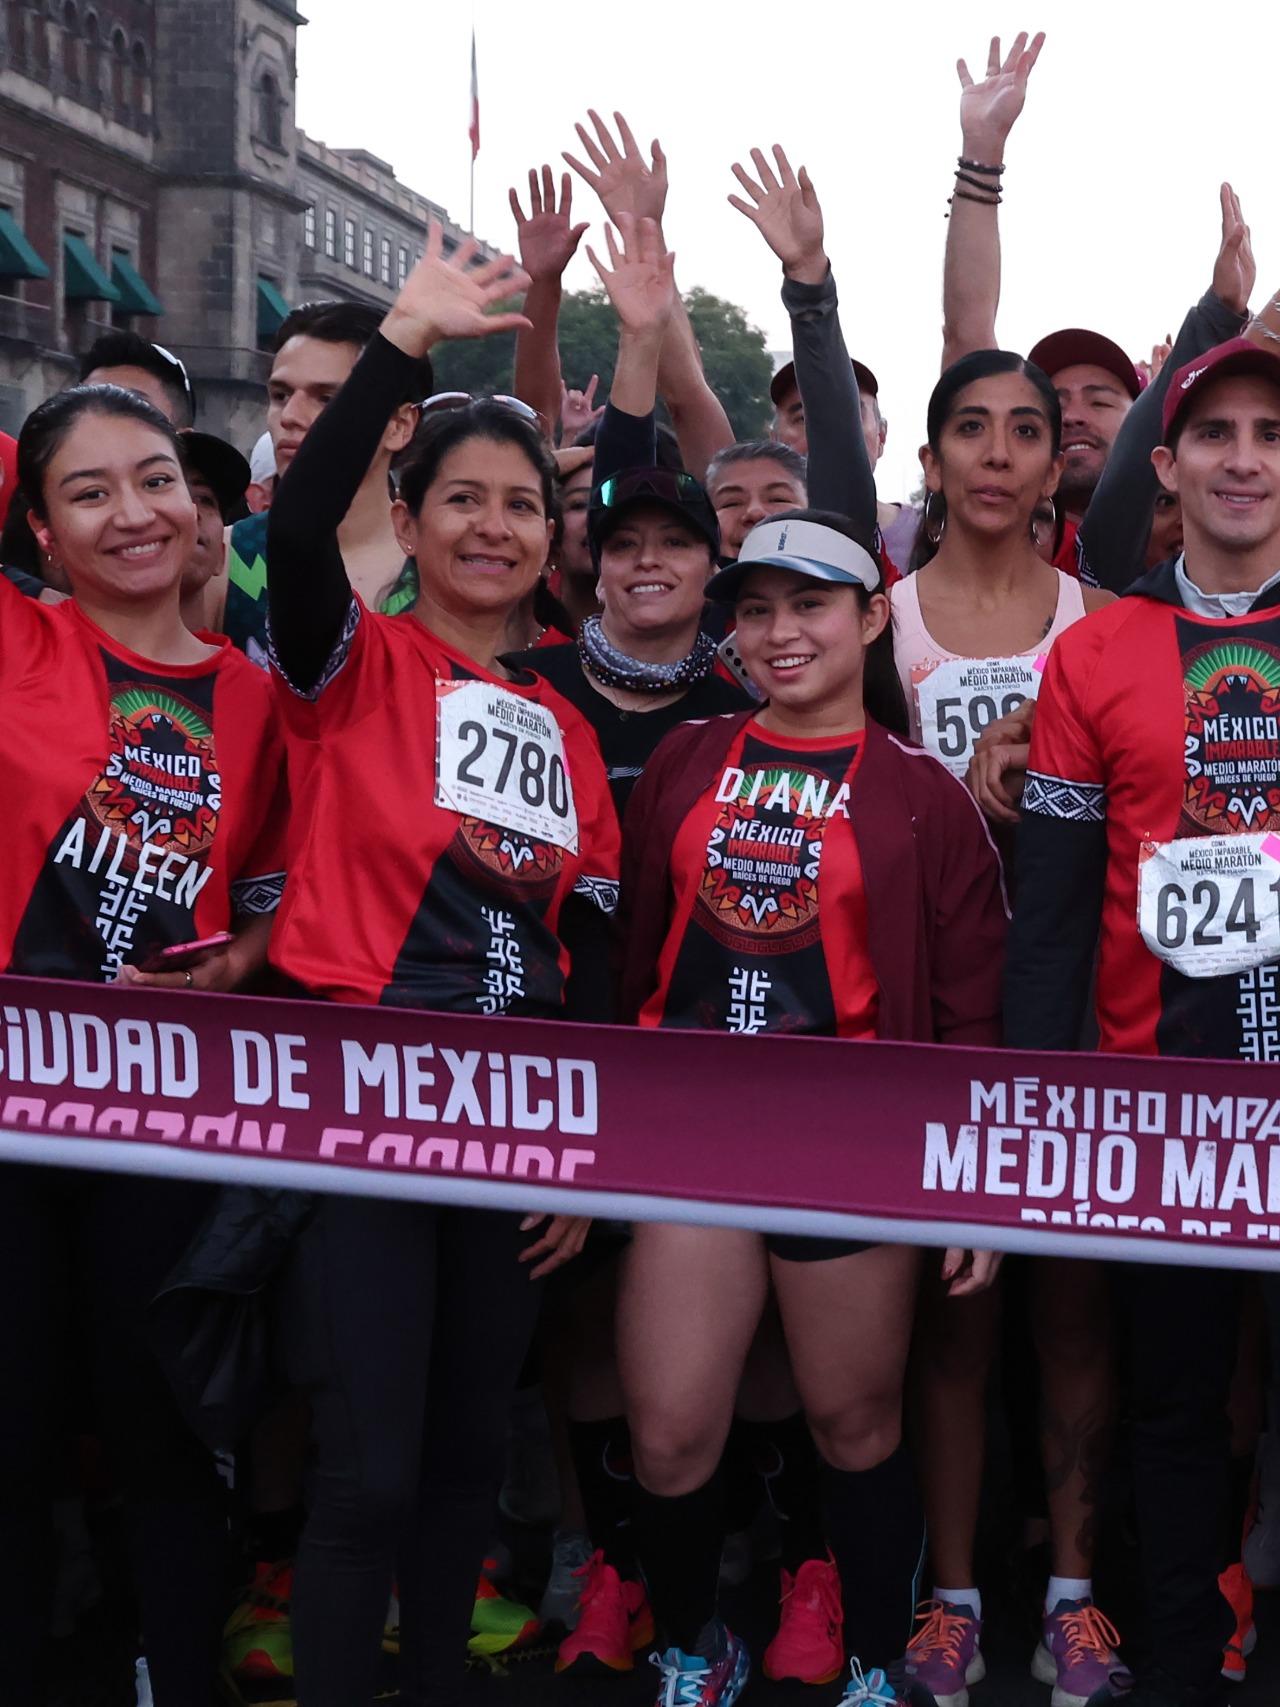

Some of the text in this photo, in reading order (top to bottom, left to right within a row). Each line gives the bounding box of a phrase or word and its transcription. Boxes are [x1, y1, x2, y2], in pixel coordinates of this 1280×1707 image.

[960, 672, 1033, 687] MEDIO MARATÓN
[488, 704, 552, 739] MEDIO MARATÓN
[1204, 714, 1278, 743] MÉXICO
[125, 745, 200, 778] MÉXICO
[1205, 740, 1280, 762] IMPARABLE
[457, 720, 569, 819] 2780
[1204, 762, 1236, 777] MEDIO
[1215, 773, 1277, 785] RAÍCES DE FUEGO
[120, 772, 204, 806] MEDIO MARATÓN
[158, 793, 169, 803] DE
[170, 797, 194, 812] FUEGO
[715, 767, 850, 839] DIANA
[730, 819, 805, 847] MÉXICO
[53, 817, 213, 910] AILEEN
[727, 838, 801, 865] IMPARABLE
[1181, 853, 1262, 872] MEDIO MARATÓN
[1189, 846, 1251, 859] MÉXICO IMPARABLE
[723, 857, 801, 879] MEDIO MARATÓN
[733, 871, 791, 887] RAÍCES DE FUEGO
[0, 1006, 199, 1098] iUDAD
[230, 1029, 310, 1110] DE
[970, 1077, 1167, 1135] MÉXICO
[923, 1122, 1137, 1204] MEDIO
